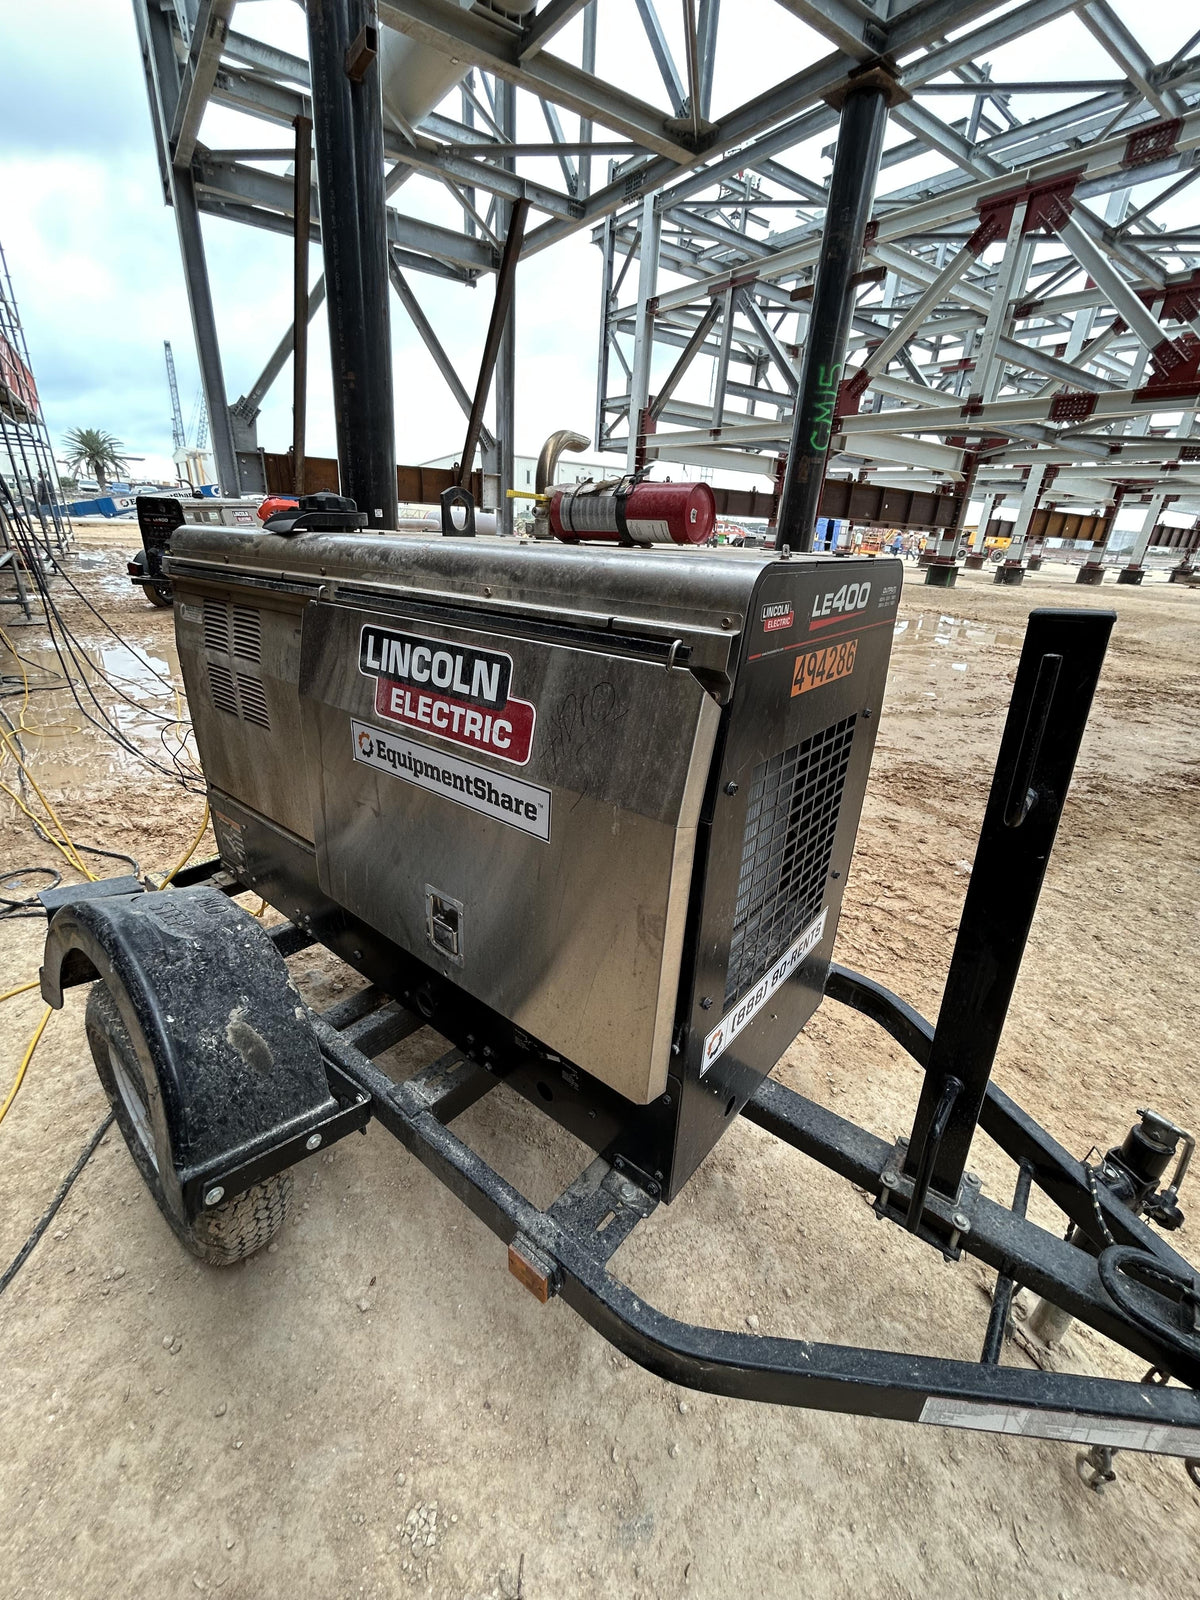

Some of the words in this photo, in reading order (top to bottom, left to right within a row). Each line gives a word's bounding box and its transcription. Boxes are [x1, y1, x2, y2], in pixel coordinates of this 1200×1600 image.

[762, 602, 790, 619] LINCOLN
[767, 616, 791, 629] ELECTRIC
[812, 581, 872, 618] LE400
[366, 634, 501, 702] LINCOLN
[793, 640, 858, 691] 494286
[390, 687, 513, 749] ELECTRIC
[376, 739, 538, 822] EquipmentShare
[731, 982, 768, 1033] (888)
[770, 920, 823, 988] 80-RENTS
